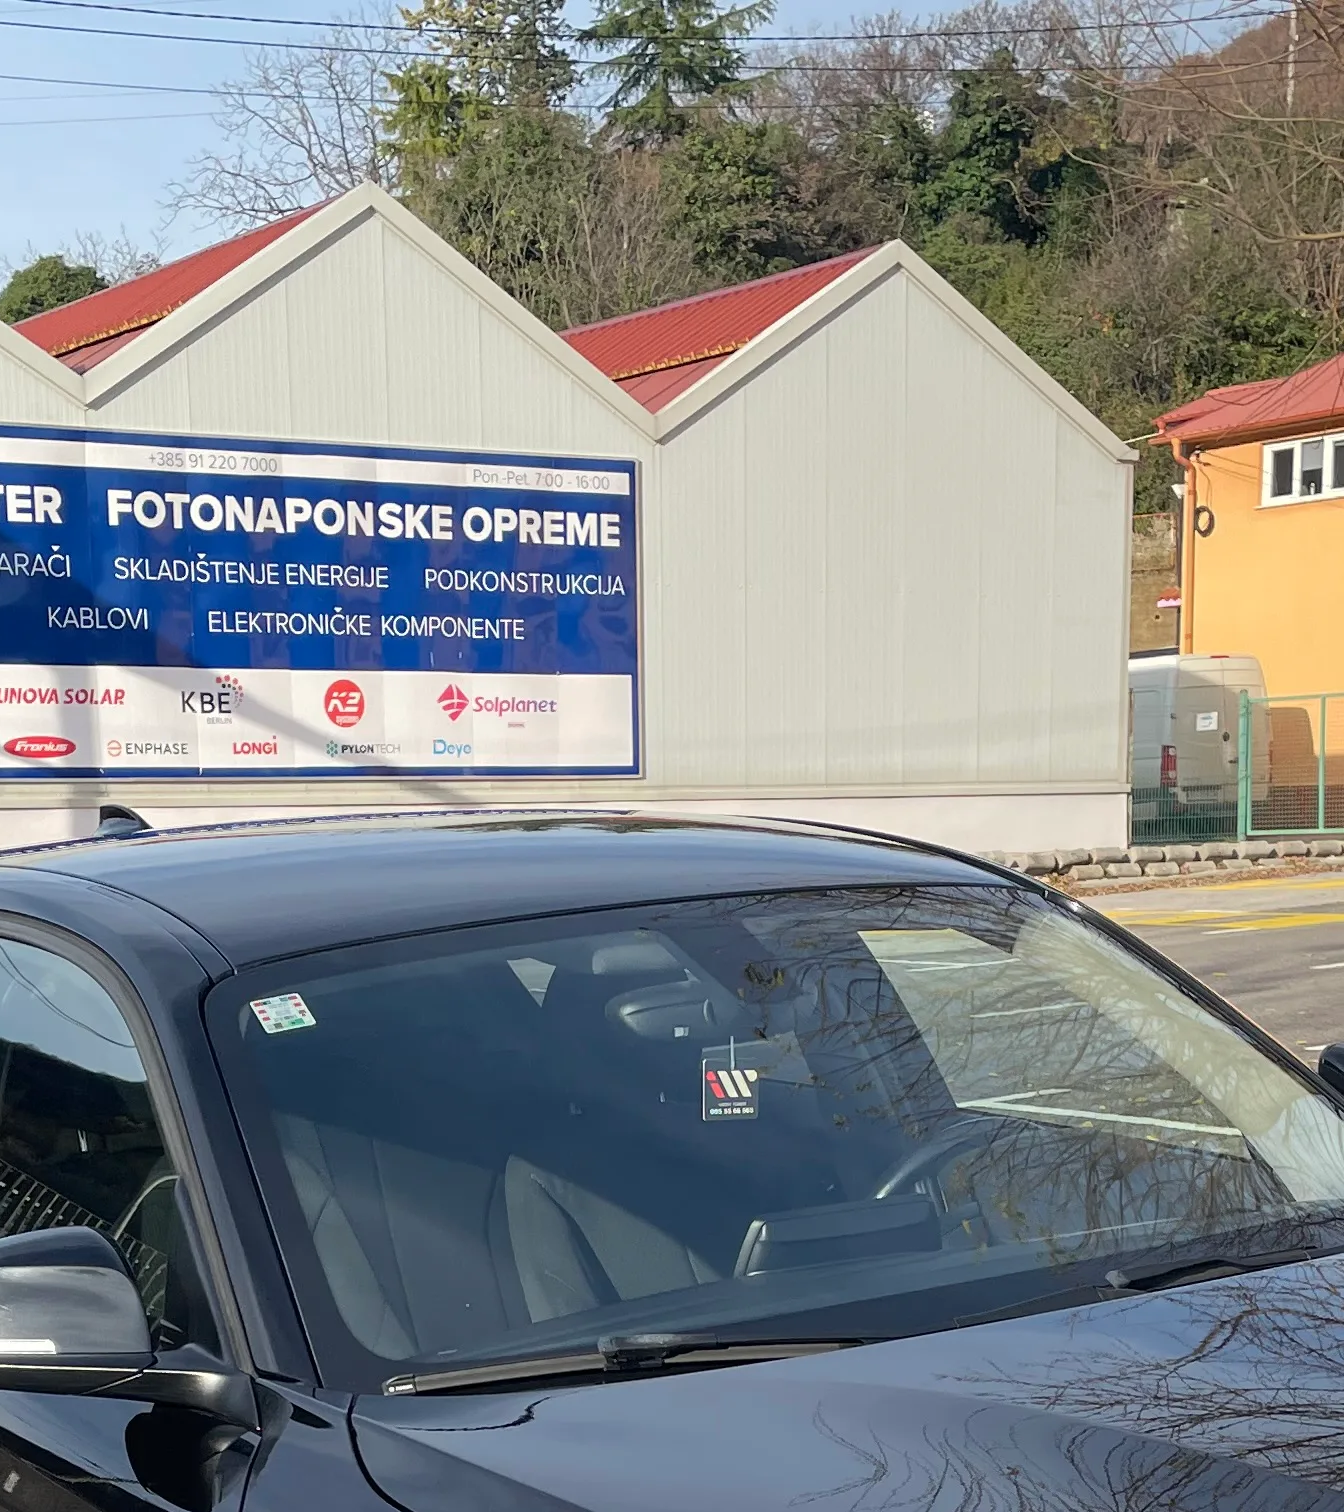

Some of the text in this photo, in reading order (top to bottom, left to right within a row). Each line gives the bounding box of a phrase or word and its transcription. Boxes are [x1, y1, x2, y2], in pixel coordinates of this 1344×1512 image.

[148, 452, 278, 473] +385 91 220 7000
[535, 472, 563, 488] 7:00
[575, 474, 610, 490] 16:00
[107, 489, 453, 541] FOTONAPONSKE
[462, 506, 621, 547] OPREME
[114, 553, 279, 585] SKLADIŠTENJE
[285, 563, 389, 588] ENERGIJE
[425, 568, 626, 596] PODKONSTRUKCIJA
[47, 606, 149, 631] KABLOVI
[208, 607, 372, 636] ELEKTRONIČKE
[381, 615, 525, 640] KOMPONENTE
[63, 688, 126, 706] SOLAR
[181, 691, 232, 714] KBE
[327, 692, 362, 713] K2
[473, 696, 557, 717] Solplanet
[14, 739, 69, 752] Fronius
[125, 743, 189, 755] ENPHASE
[341, 744, 401, 755] PYLONTECH
